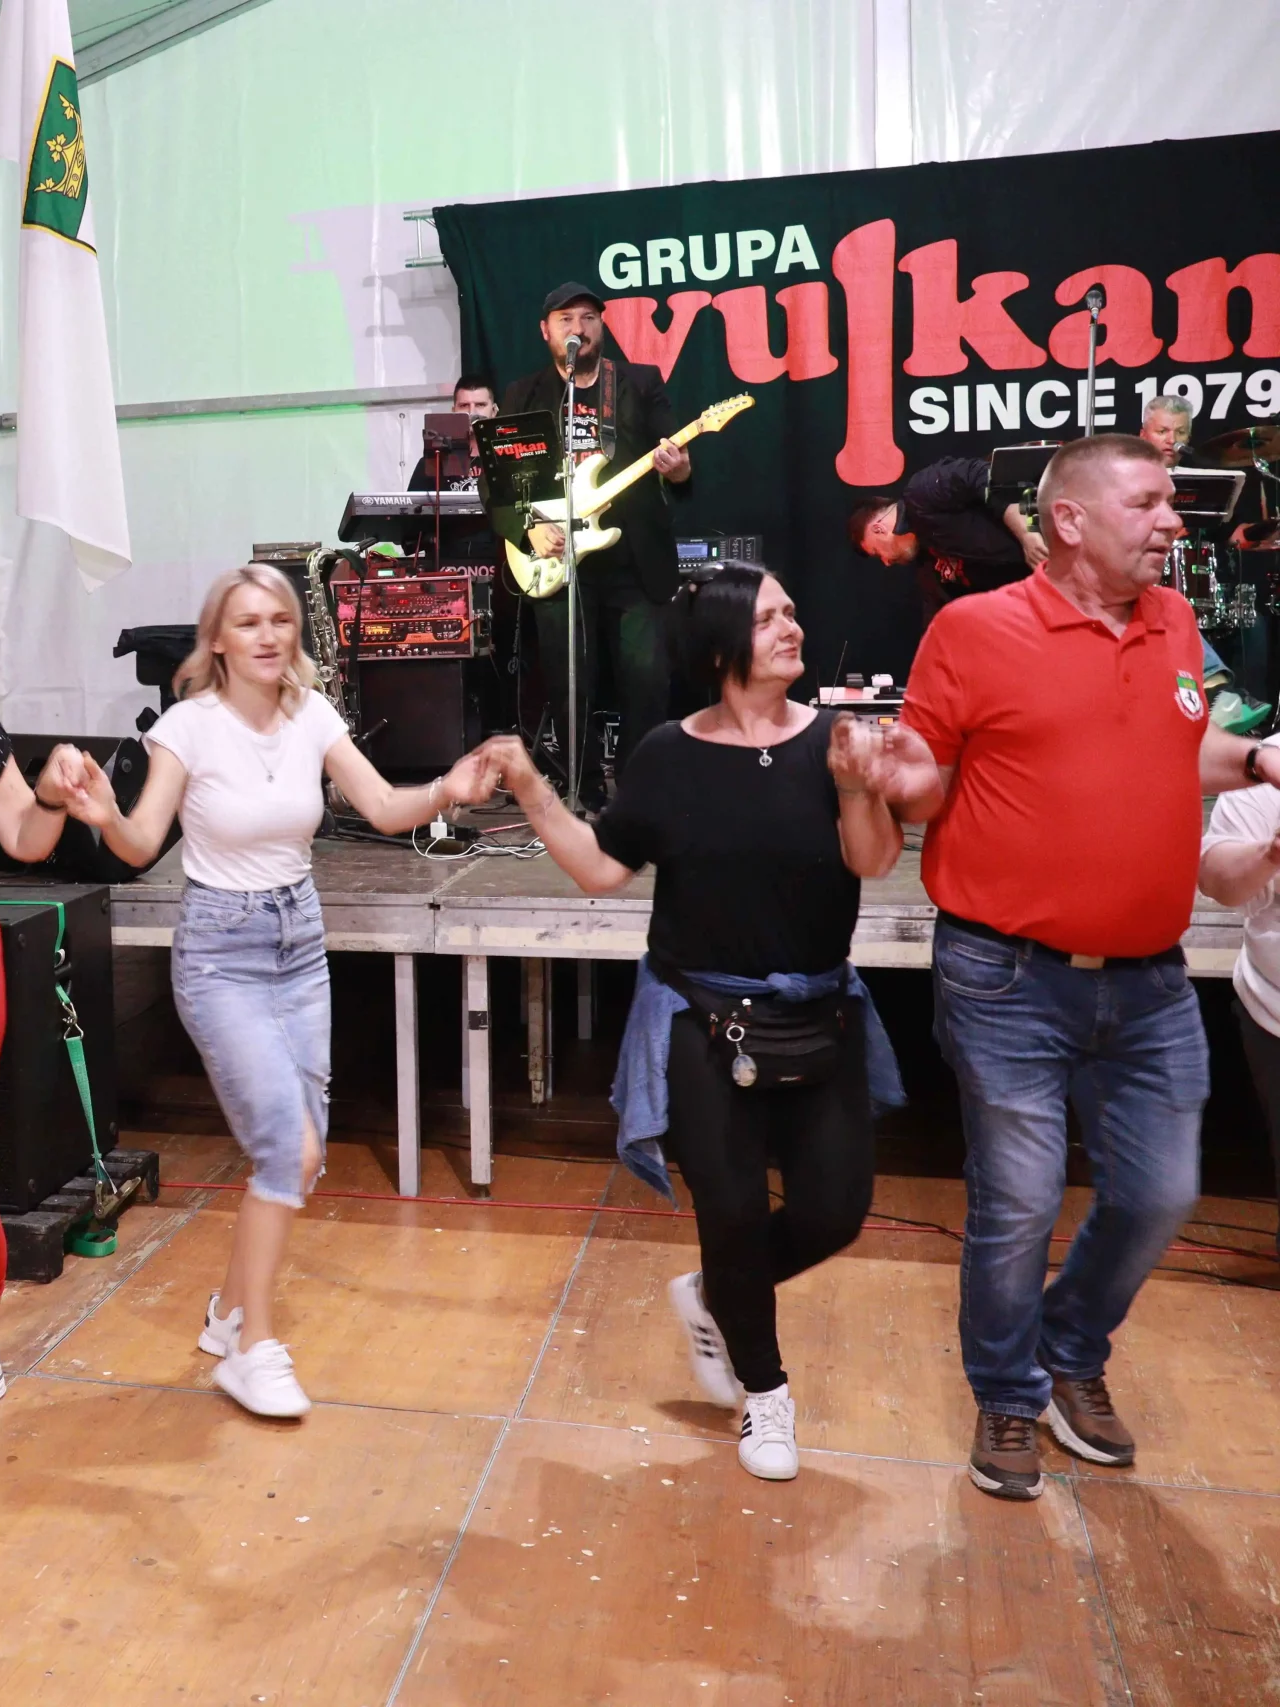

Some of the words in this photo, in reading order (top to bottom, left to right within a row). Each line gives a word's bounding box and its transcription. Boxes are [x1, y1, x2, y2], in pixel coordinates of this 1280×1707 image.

[598, 224, 821, 290] GRUPA
[601, 218, 1280, 487] vulkan
[908, 377, 1117, 435] SINCE
[1134, 369, 1280, 424] 1979
[495, 441, 548, 460] vulkan
[373, 496, 413, 505] YAMAHA
